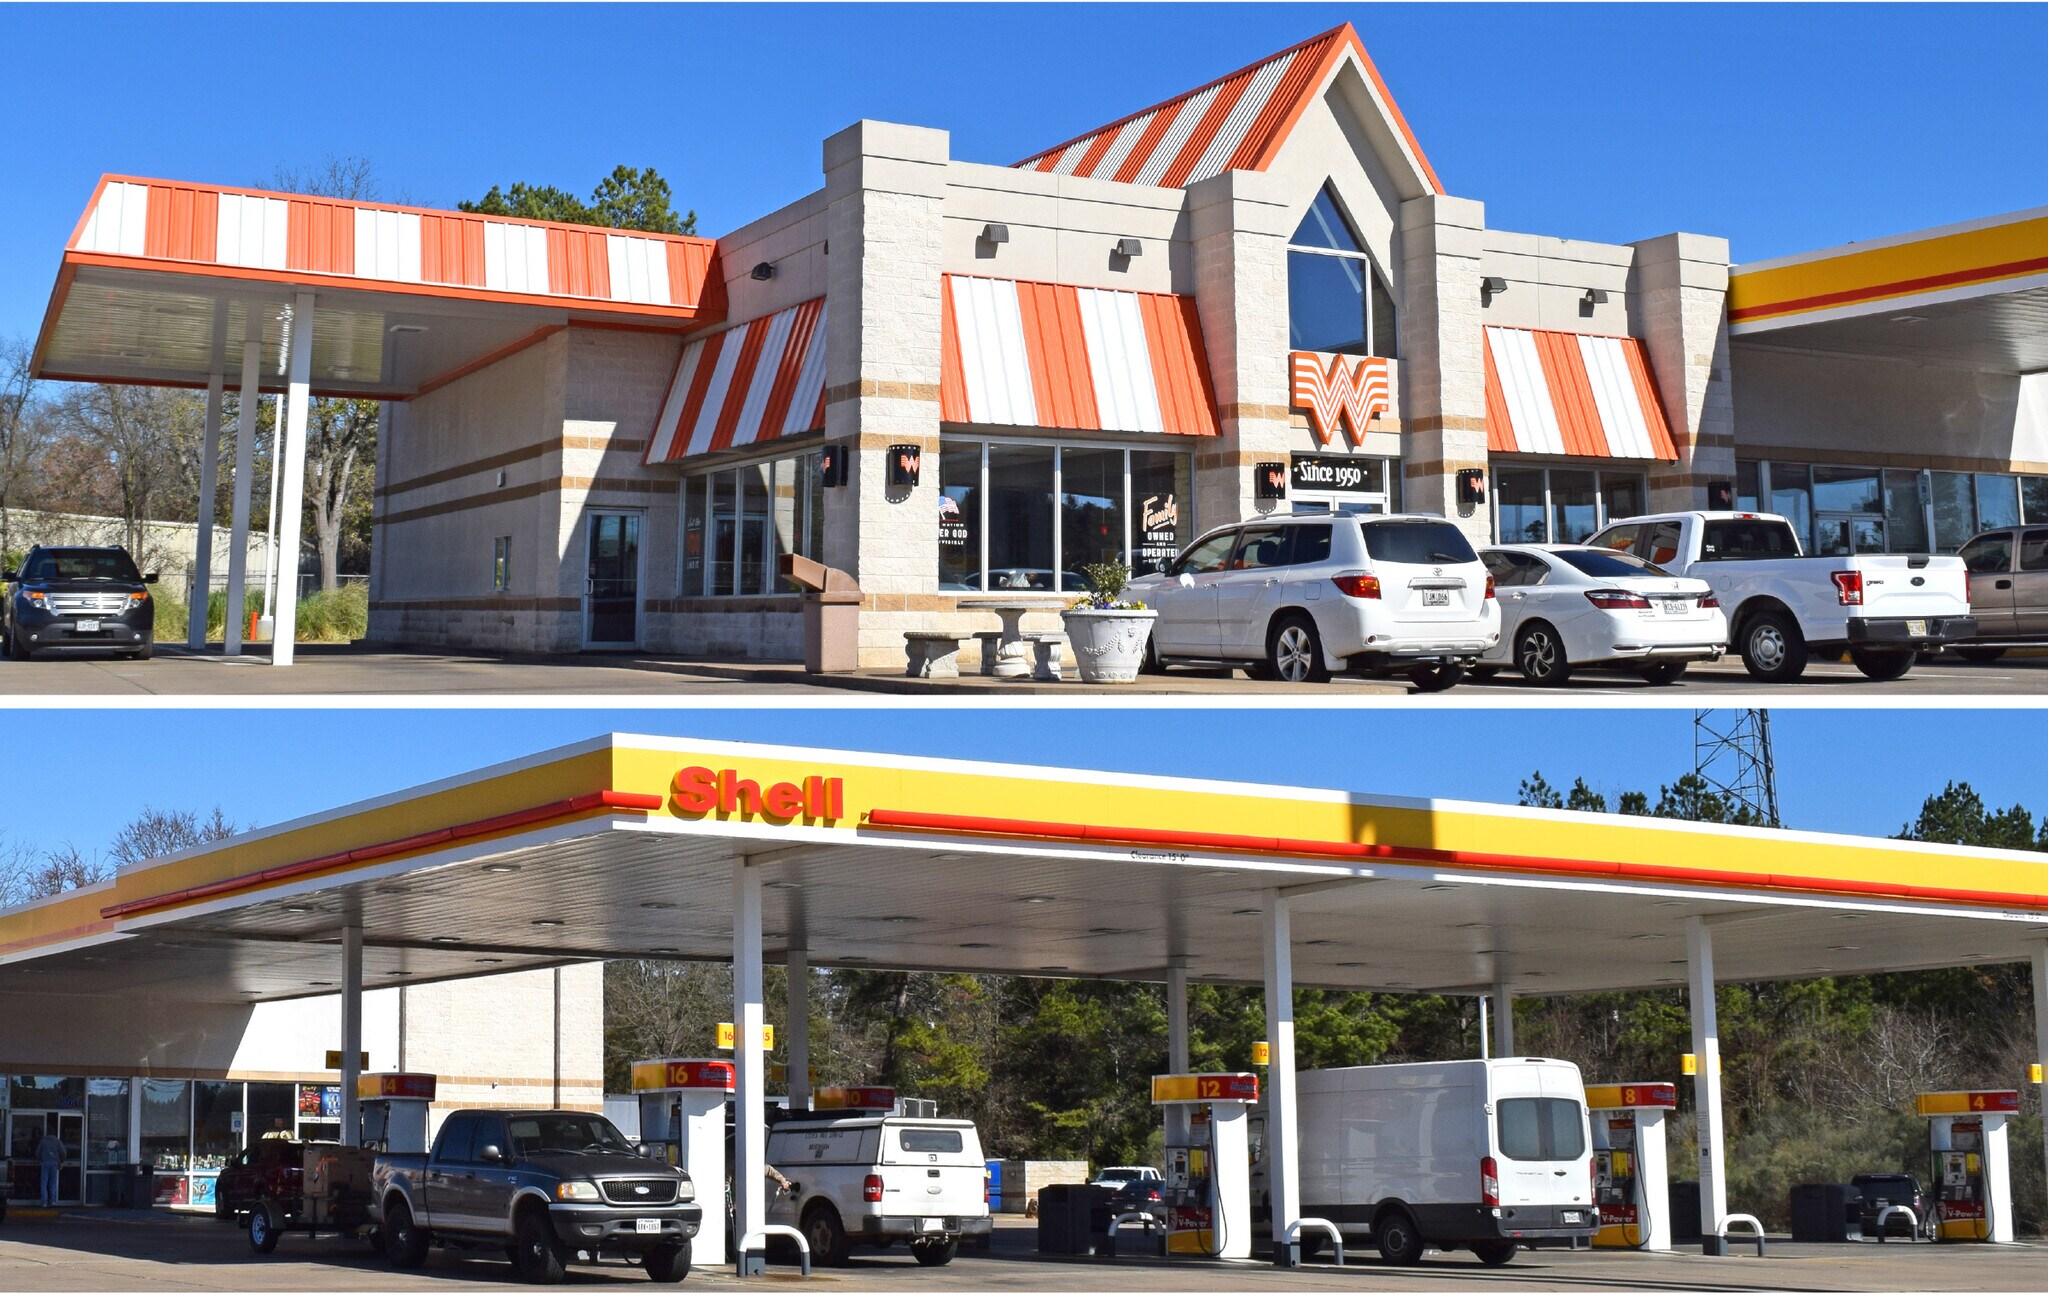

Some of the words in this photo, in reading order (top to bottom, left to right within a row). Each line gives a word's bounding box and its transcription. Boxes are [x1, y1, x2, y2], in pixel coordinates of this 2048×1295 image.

[1289, 352, 1389, 447] W
[1300, 461, 1333, 481] Since
[1335, 466, 1361, 487] 1950
[1143, 494, 1178, 532] Family
[952, 529, 968, 538] GOD
[1147, 532, 1174, 541] OWNED
[671, 766, 844, 821] Shell
[1130, 850, 1166, 861] Clearance
[724, 1031, 734, 1041] 16
[1259, 1048, 1268, 1057] 12
[669, 1065, 689, 1085] 16
[382, 1079, 397, 1093] 14
[1201, 1080, 1221, 1098] 12
[847, 1089, 861, 1106] 10
[1625, 1088, 1636, 1104] 8
[1973, 1095, 1986, 1110] 4
[1601, 1214, 1634, 1223] V-Power
[1945, 1210, 1981, 1218] V-Power
